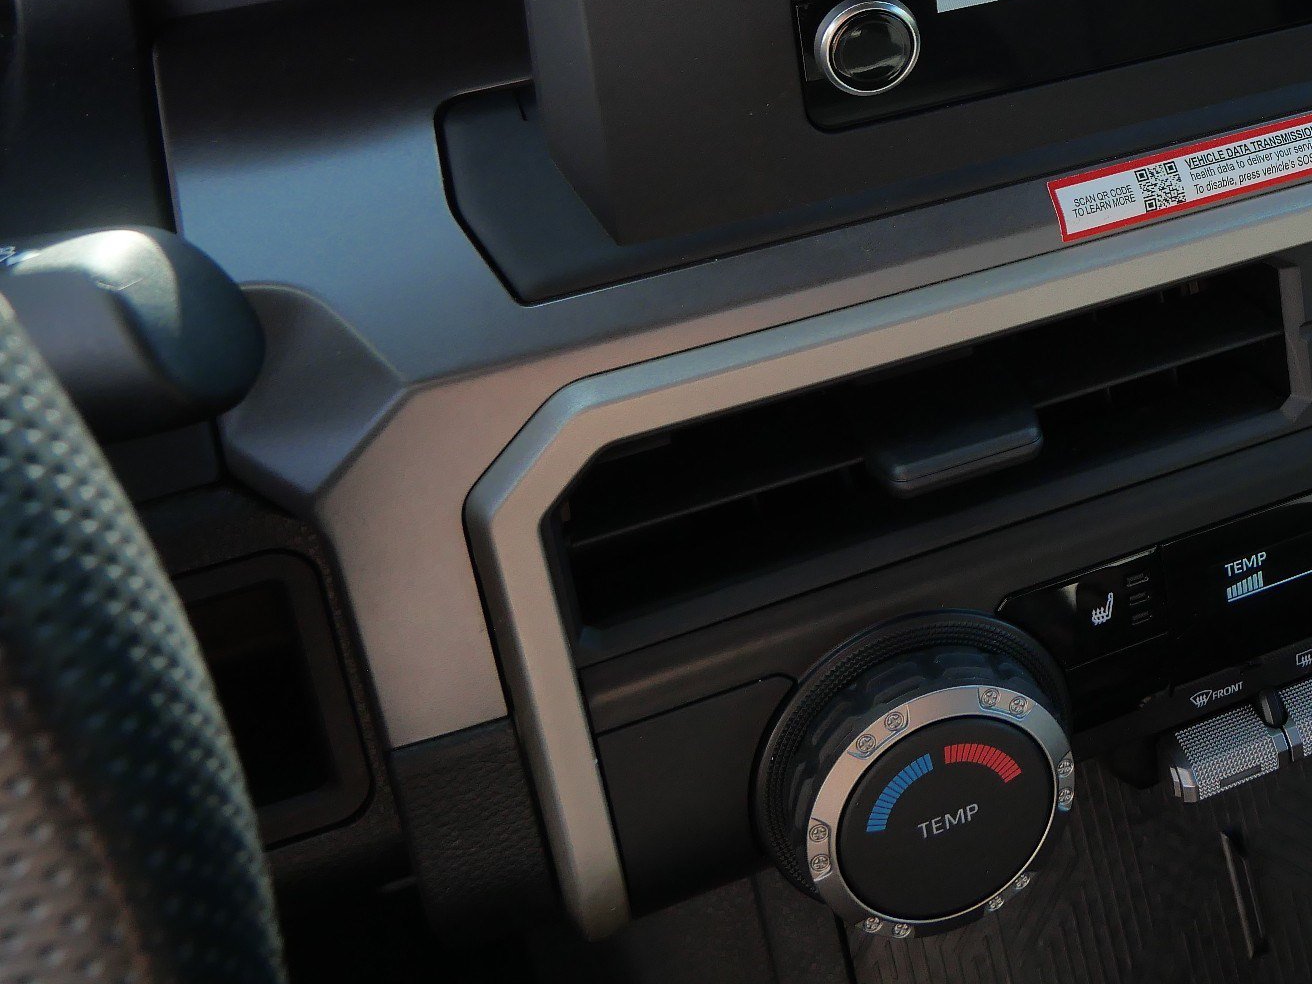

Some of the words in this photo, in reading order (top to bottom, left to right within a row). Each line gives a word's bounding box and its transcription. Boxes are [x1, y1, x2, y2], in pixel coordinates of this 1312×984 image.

[1185, 150, 1224, 167] VEHICLE
[1226, 144, 1250, 158] DATA
[1190, 168, 1216, 181] health
[1217, 163, 1235, 175] data
[1237, 159, 1246, 169] to
[1248, 153, 1273, 166] deliver
[1274, 148, 1293, 163] your
[1194, 182, 1205, 195] To
[1238, 170, 1261, 185] press
[1262, 158, 1296, 176] vehicle's
[1072, 208, 1085, 218] TO
[1086, 200, 1112, 214] LEARN
[1112, 194, 1136, 207] MORE
[1074, 196, 1096, 207] SCAN
[1097, 191, 1109, 201] QR
[1110, 185, 1133, 197] CODE
[1224, 551, 1267, 577] TEMP
[1212, 681, 1244, 702] FRONT
[917, 803, 979, 839] TEMP
